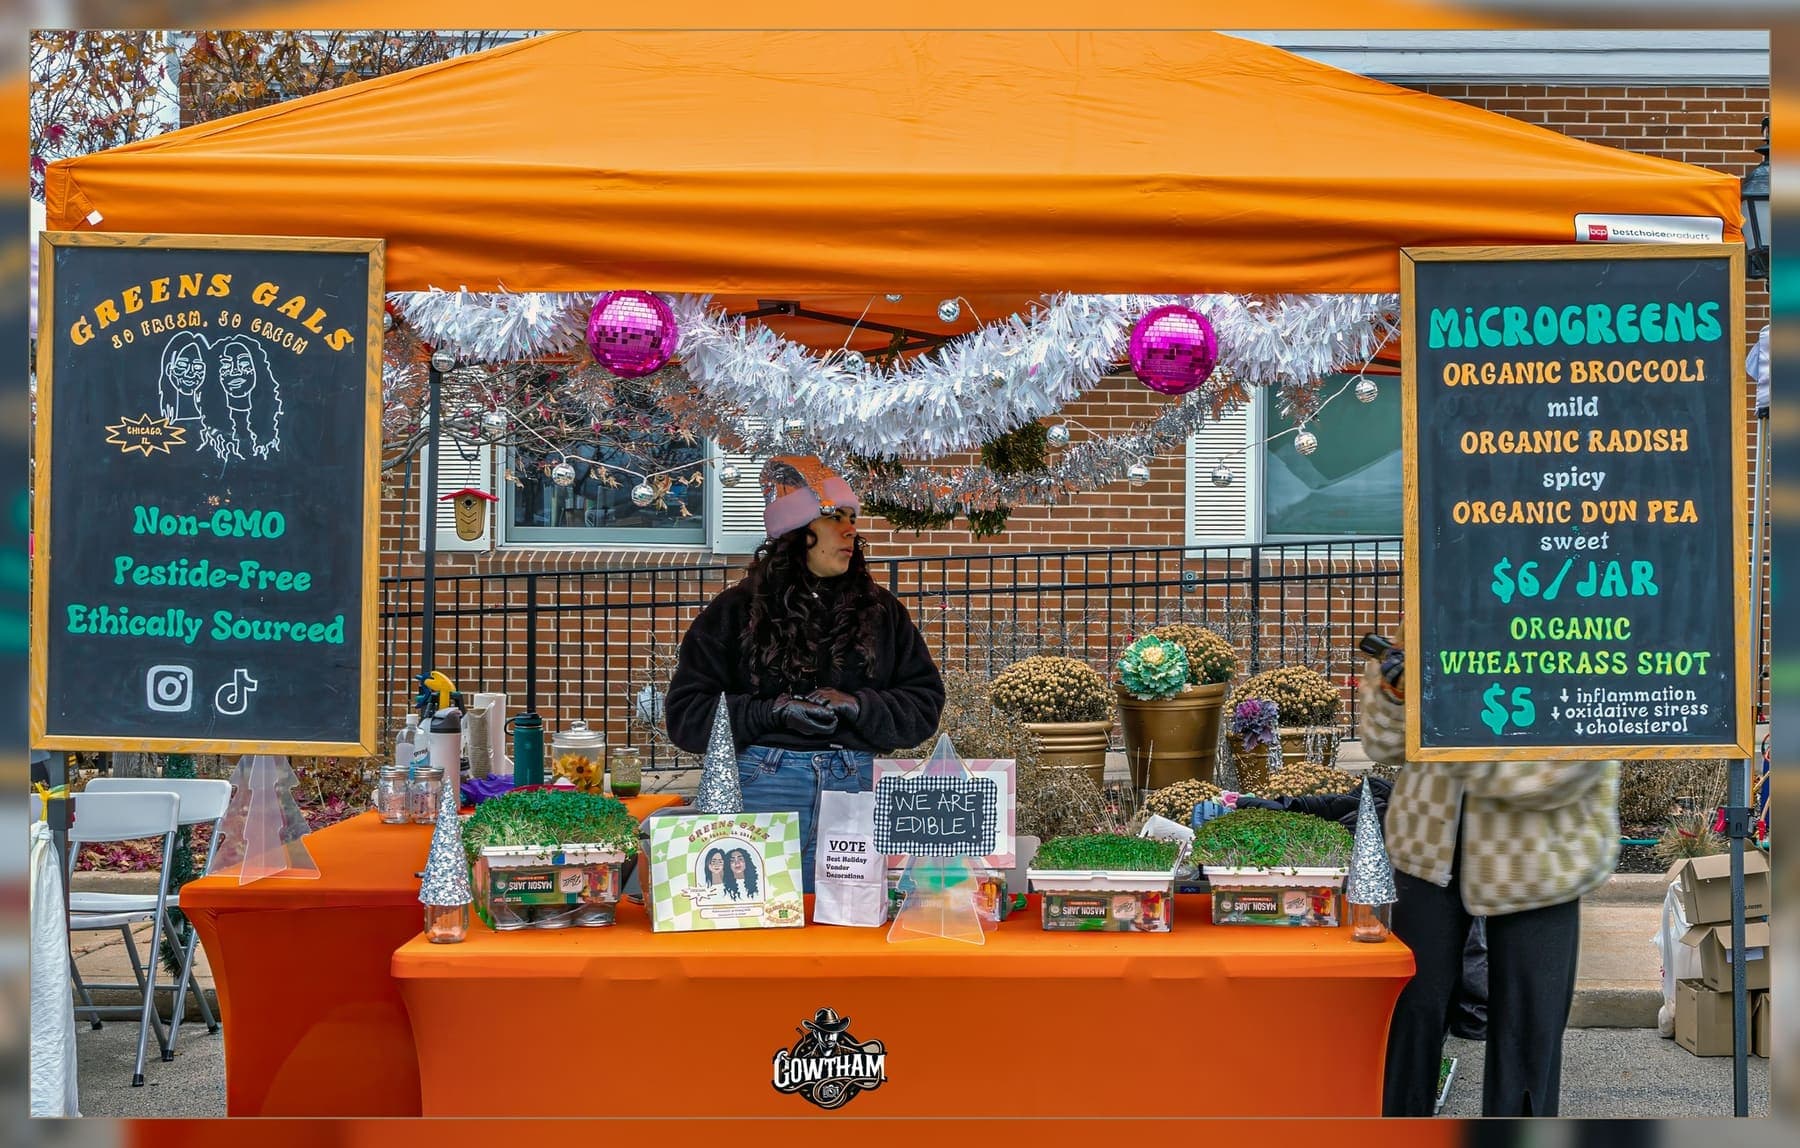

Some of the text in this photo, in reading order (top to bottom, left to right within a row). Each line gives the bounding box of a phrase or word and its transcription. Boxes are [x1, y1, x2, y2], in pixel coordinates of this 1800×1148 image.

[1612, 228, 1710, 241] bestchoiceproducts
[70, 274, 354, 351] GREENS GALS
[219, 311, 241, 327] SO
[251, 319, 308, 354] GREEN
[1443, 359, 1704, 386] ORGANIC BROCCOLI
[1548, 396, 1598, 417] mild
[141, 437, 151, 445] IL
[1461, 429, 1688, 454] ORGANIC RADISH
[1543, 466, 1605, 491] spicy
[133, 506, 285, 538] Non-GMO
[1453, 500, 1698, 524] ORGANIC DUN PEA
[1540, 531, 1609, 551] sweet
[114, 556, 311, 592] Pestide-Free
[66, 604, 344, 644] Ethically Sourced
[1511, 617, 1631, 640] ORGANIC
[1440, 651, 1710, 675] WHEATGRASS SHOT
[1577, 686, 1697, 703] inflammation
[1481, 683, 1535, 735] $5
[1565, 702, 1708, 719] oxidative stress
[1587, 718, 1688, 735] cholesterol
[895, 793, 976, 812] WE ARE
[688, 820, 735, 843] GREENS
[739, 821, 770, 840] GALS
[829, 840, 866, 852] VOTE
[826, 863, 850, 871] Vendor
[842, 856, 867, 864] Holiday
[509, 881, 553, 891] MASON JARS
[1062, 906, 1106, 916] MASON JARS
[1234, 901, 1277, 911] MASON JARS
